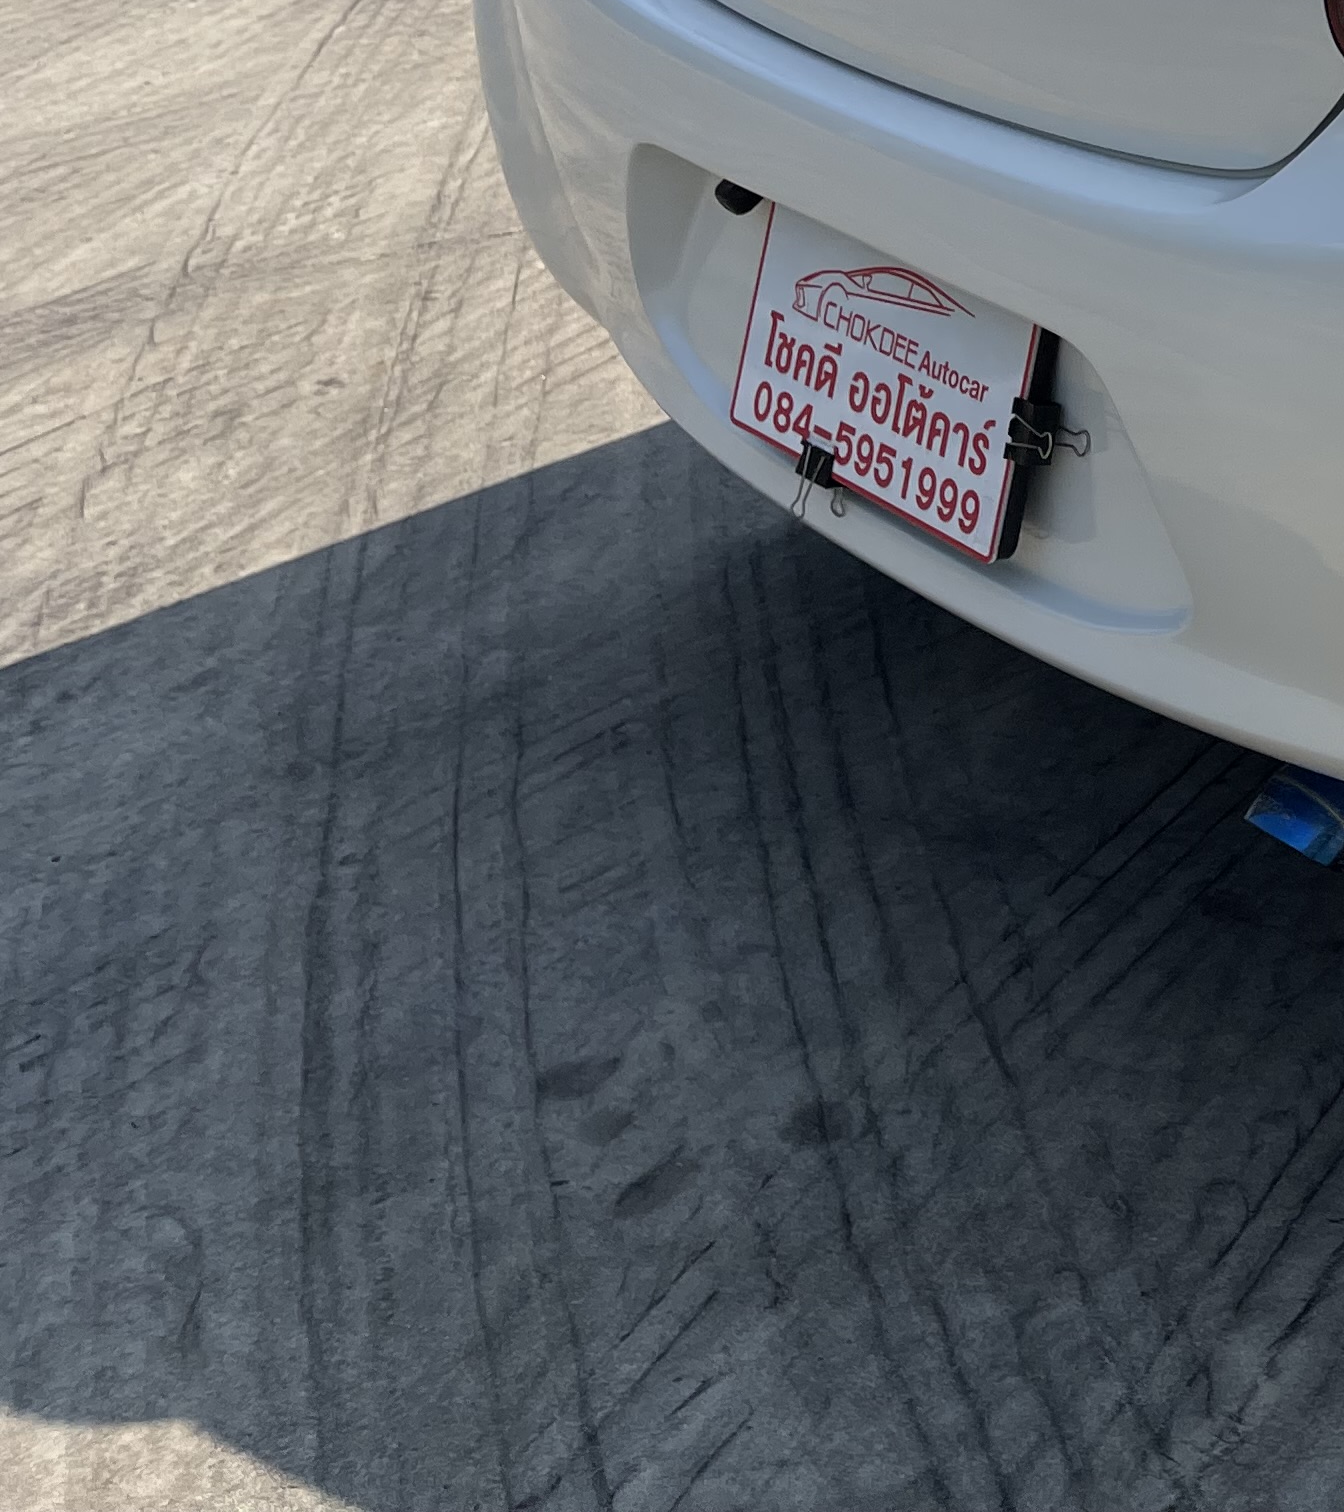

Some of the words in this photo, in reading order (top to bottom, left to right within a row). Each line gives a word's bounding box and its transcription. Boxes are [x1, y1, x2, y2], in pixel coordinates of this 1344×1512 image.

[763, 309, 843, 400] โชคดี
[848, 371, 997, 476] ออโต้คาร์
[823, 300, 919, 369] CHOKDEE
[918, 350, 990, 403] Autocar
[753, 380, 981, 535] 084-5951999
